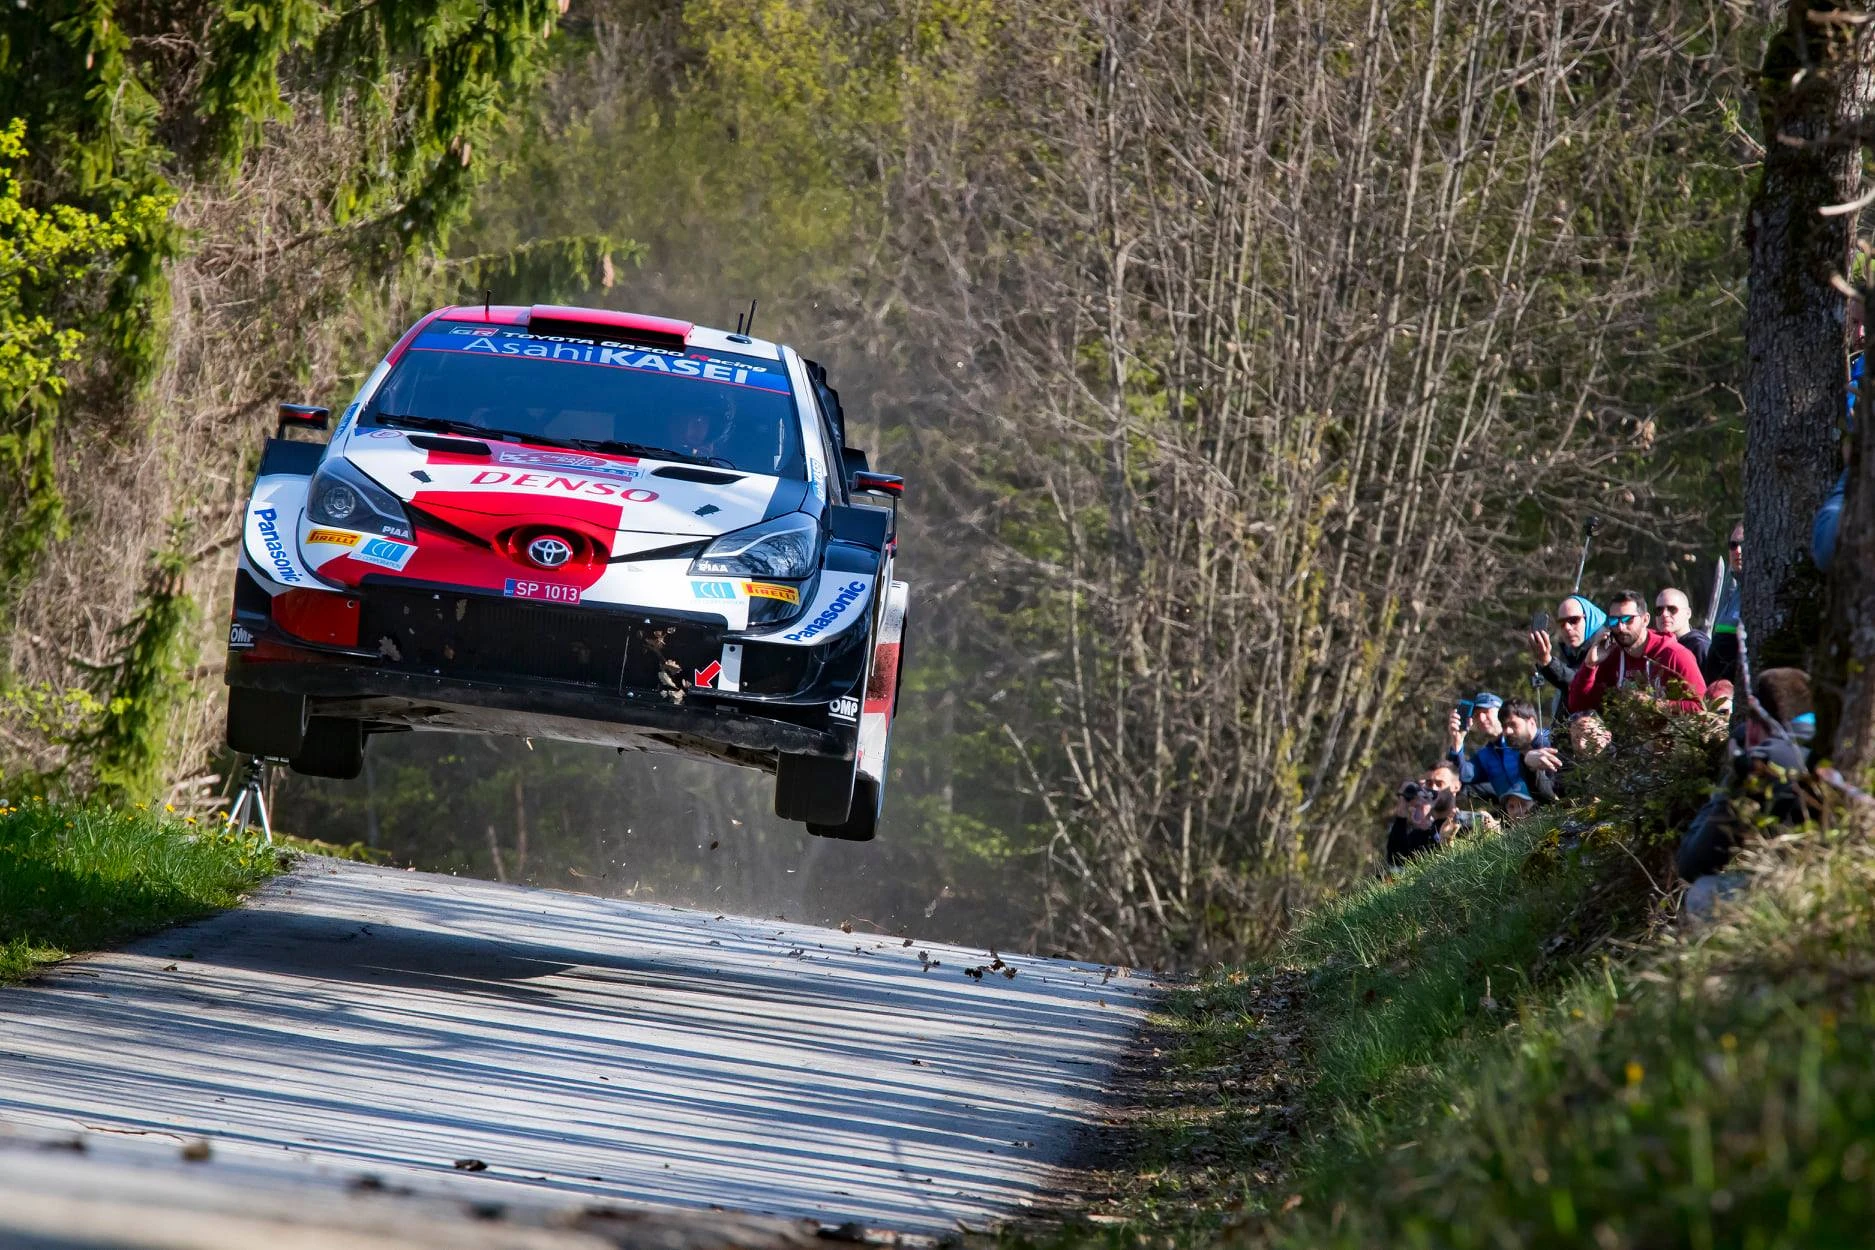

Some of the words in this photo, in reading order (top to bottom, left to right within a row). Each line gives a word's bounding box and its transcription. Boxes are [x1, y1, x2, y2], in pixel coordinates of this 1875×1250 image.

[503, 332, 594, 345] TOYOTA
[600, 341, 685, 357] GAZOO
[689, 353, 767, 373] Racing
[470, 471, 660, 503] DENSO
[310, 530, 359, 545] PIRELLI
[382, 525, 410, 538] PIAA
[254, 508, 302, 582] Panasonic
[699, 562, 729, 573] PIAA
[516, 582, 539, 597] SP
[545, 585, 578, 602] 1013
[746, 583, 797, 601] PIRELLI
[783, 580, 866, 642] Panasonic
[829, 700, 858, 717] OMP
